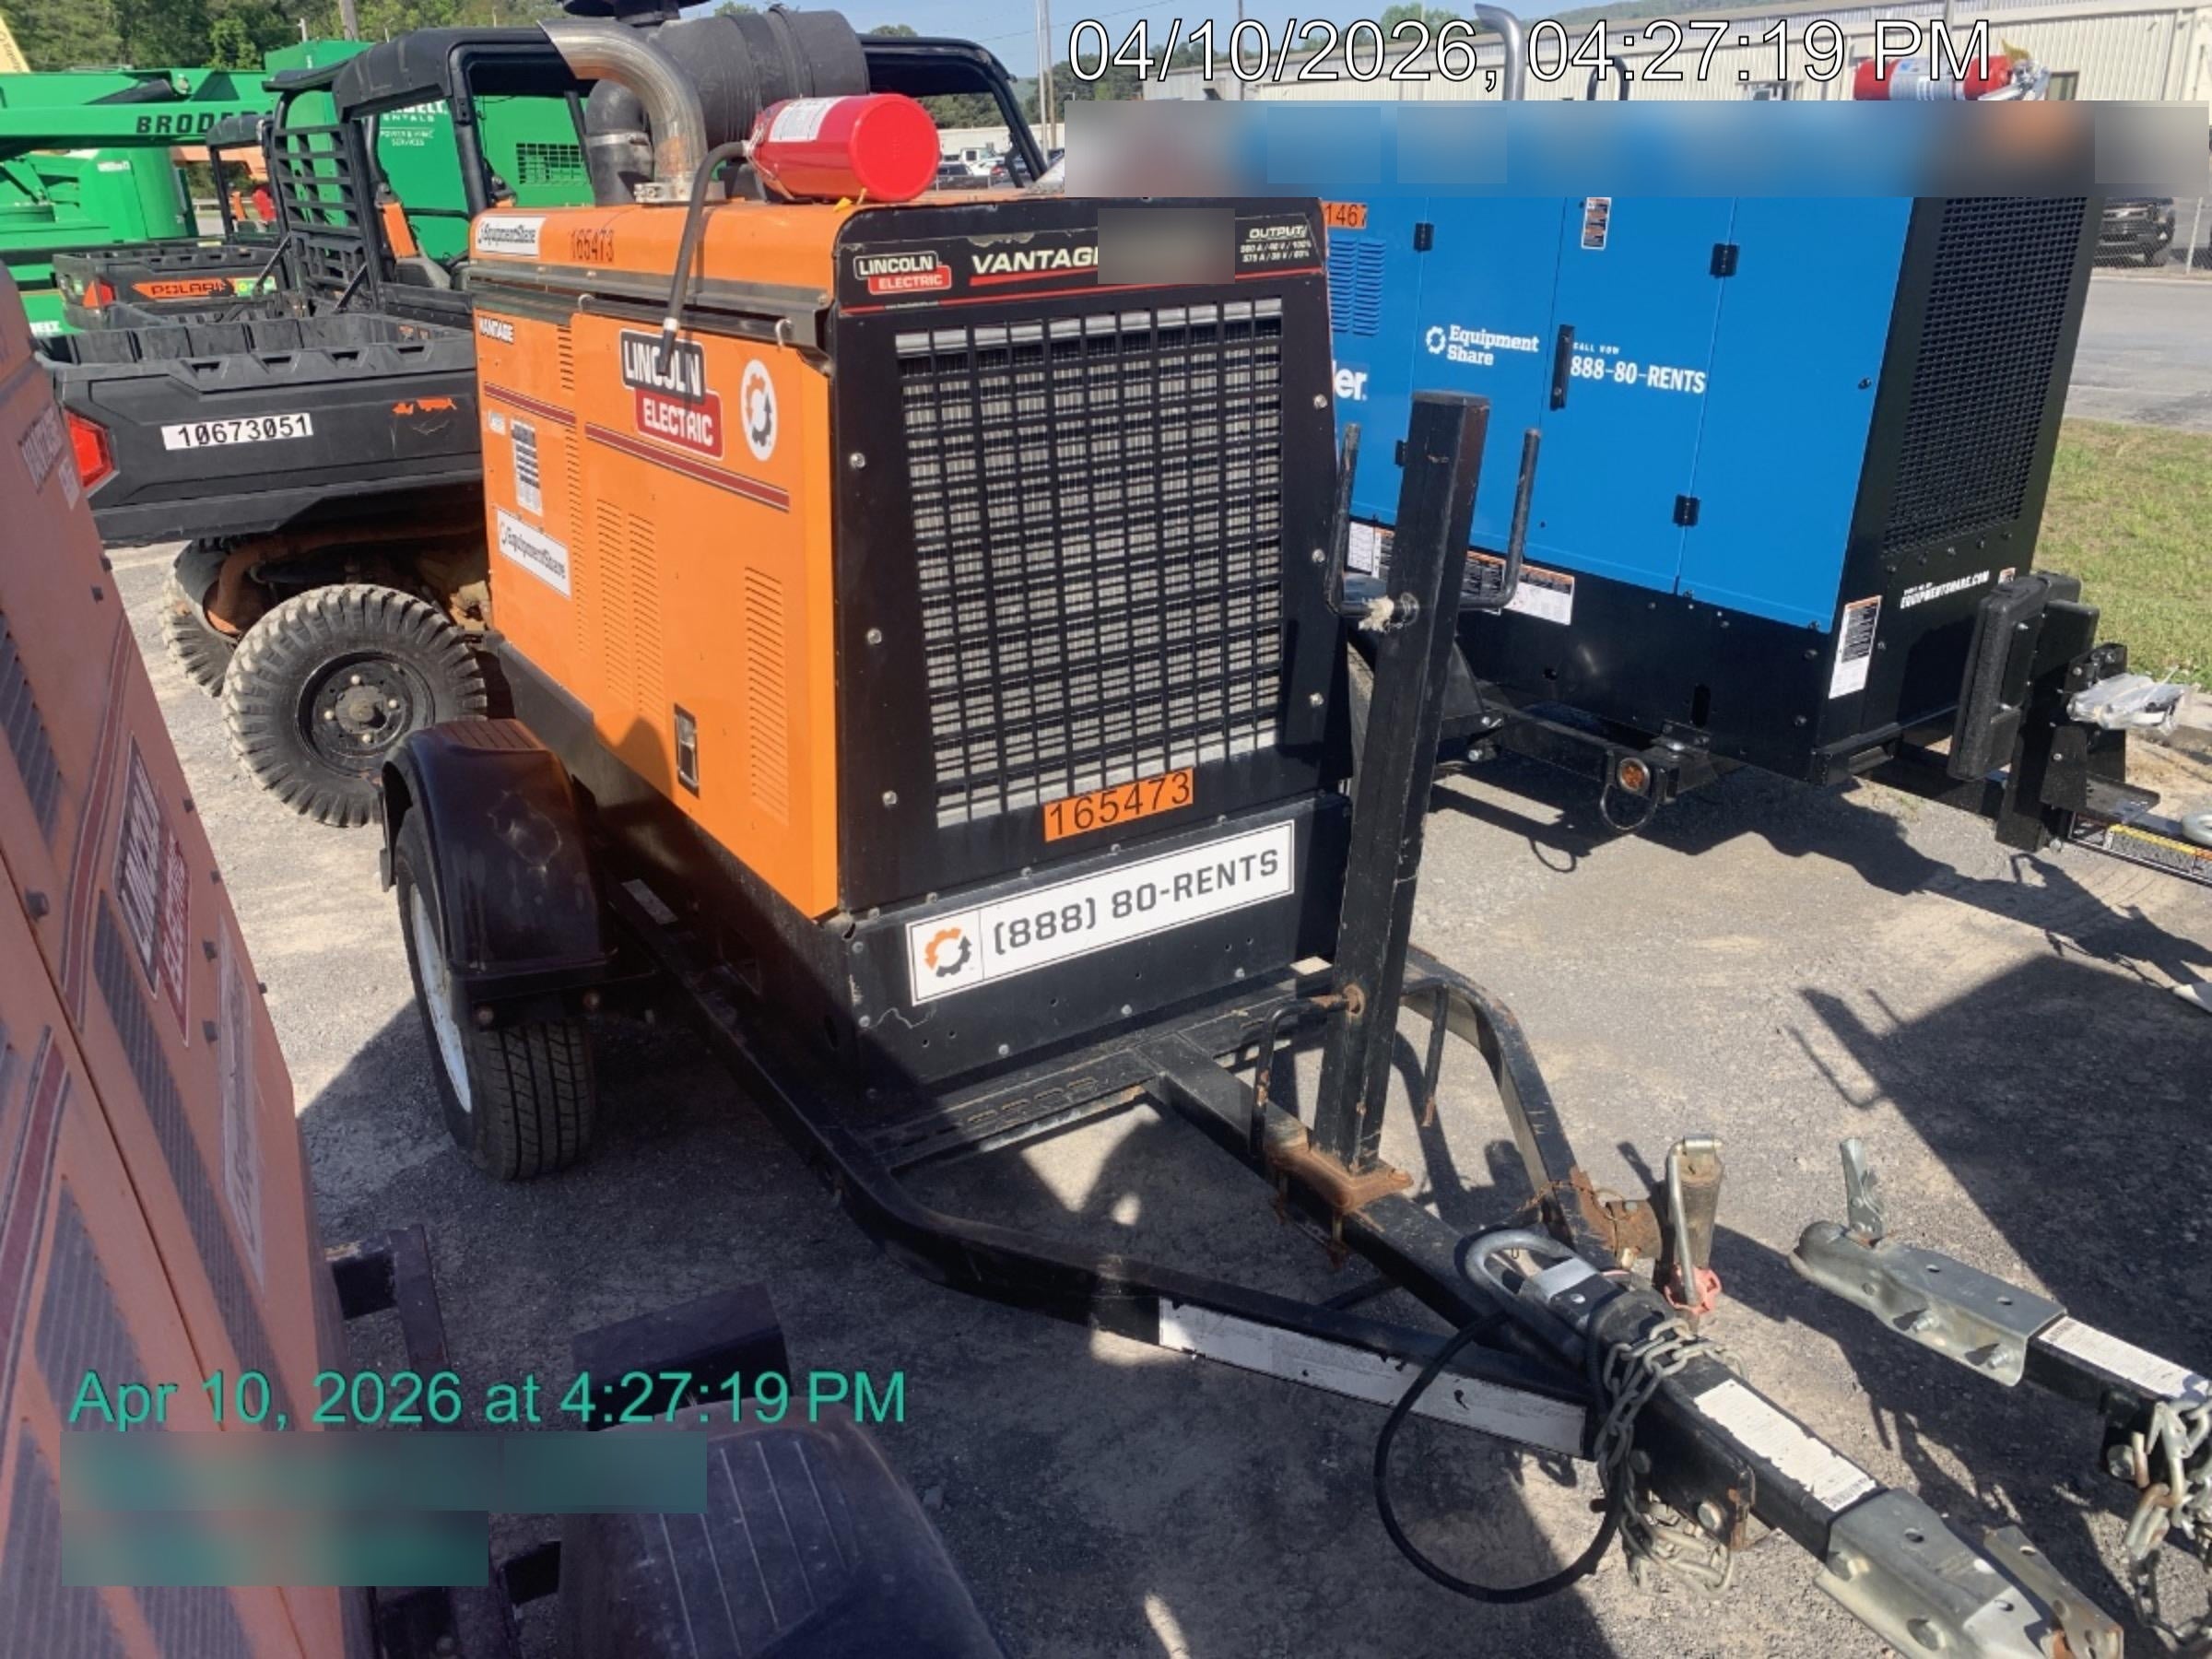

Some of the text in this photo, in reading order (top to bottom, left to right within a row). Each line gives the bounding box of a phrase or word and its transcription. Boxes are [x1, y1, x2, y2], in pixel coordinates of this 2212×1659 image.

[381, 112, 435, 122] ENTALS
[570, 229, 615, 263] 165473
[1249, 225, 1306, 239] OUTPUT
[858, 255, 934, 276] LINCOLN
[878, 274, 943, 290] ELECTRIC
[1448, 324, 1540, 352] Equipment
[1446, 344, 1494, 366] Share
[1570, 355, 1707, 394] 888-80-RENTS
[178, 415, 308, 447] 10673051
[642, 397, 714, 447] ELECTRIC
[1050, 771, 1191, 835] 165473
[994, 848, 1279, 956] (888) 80-RENTS
